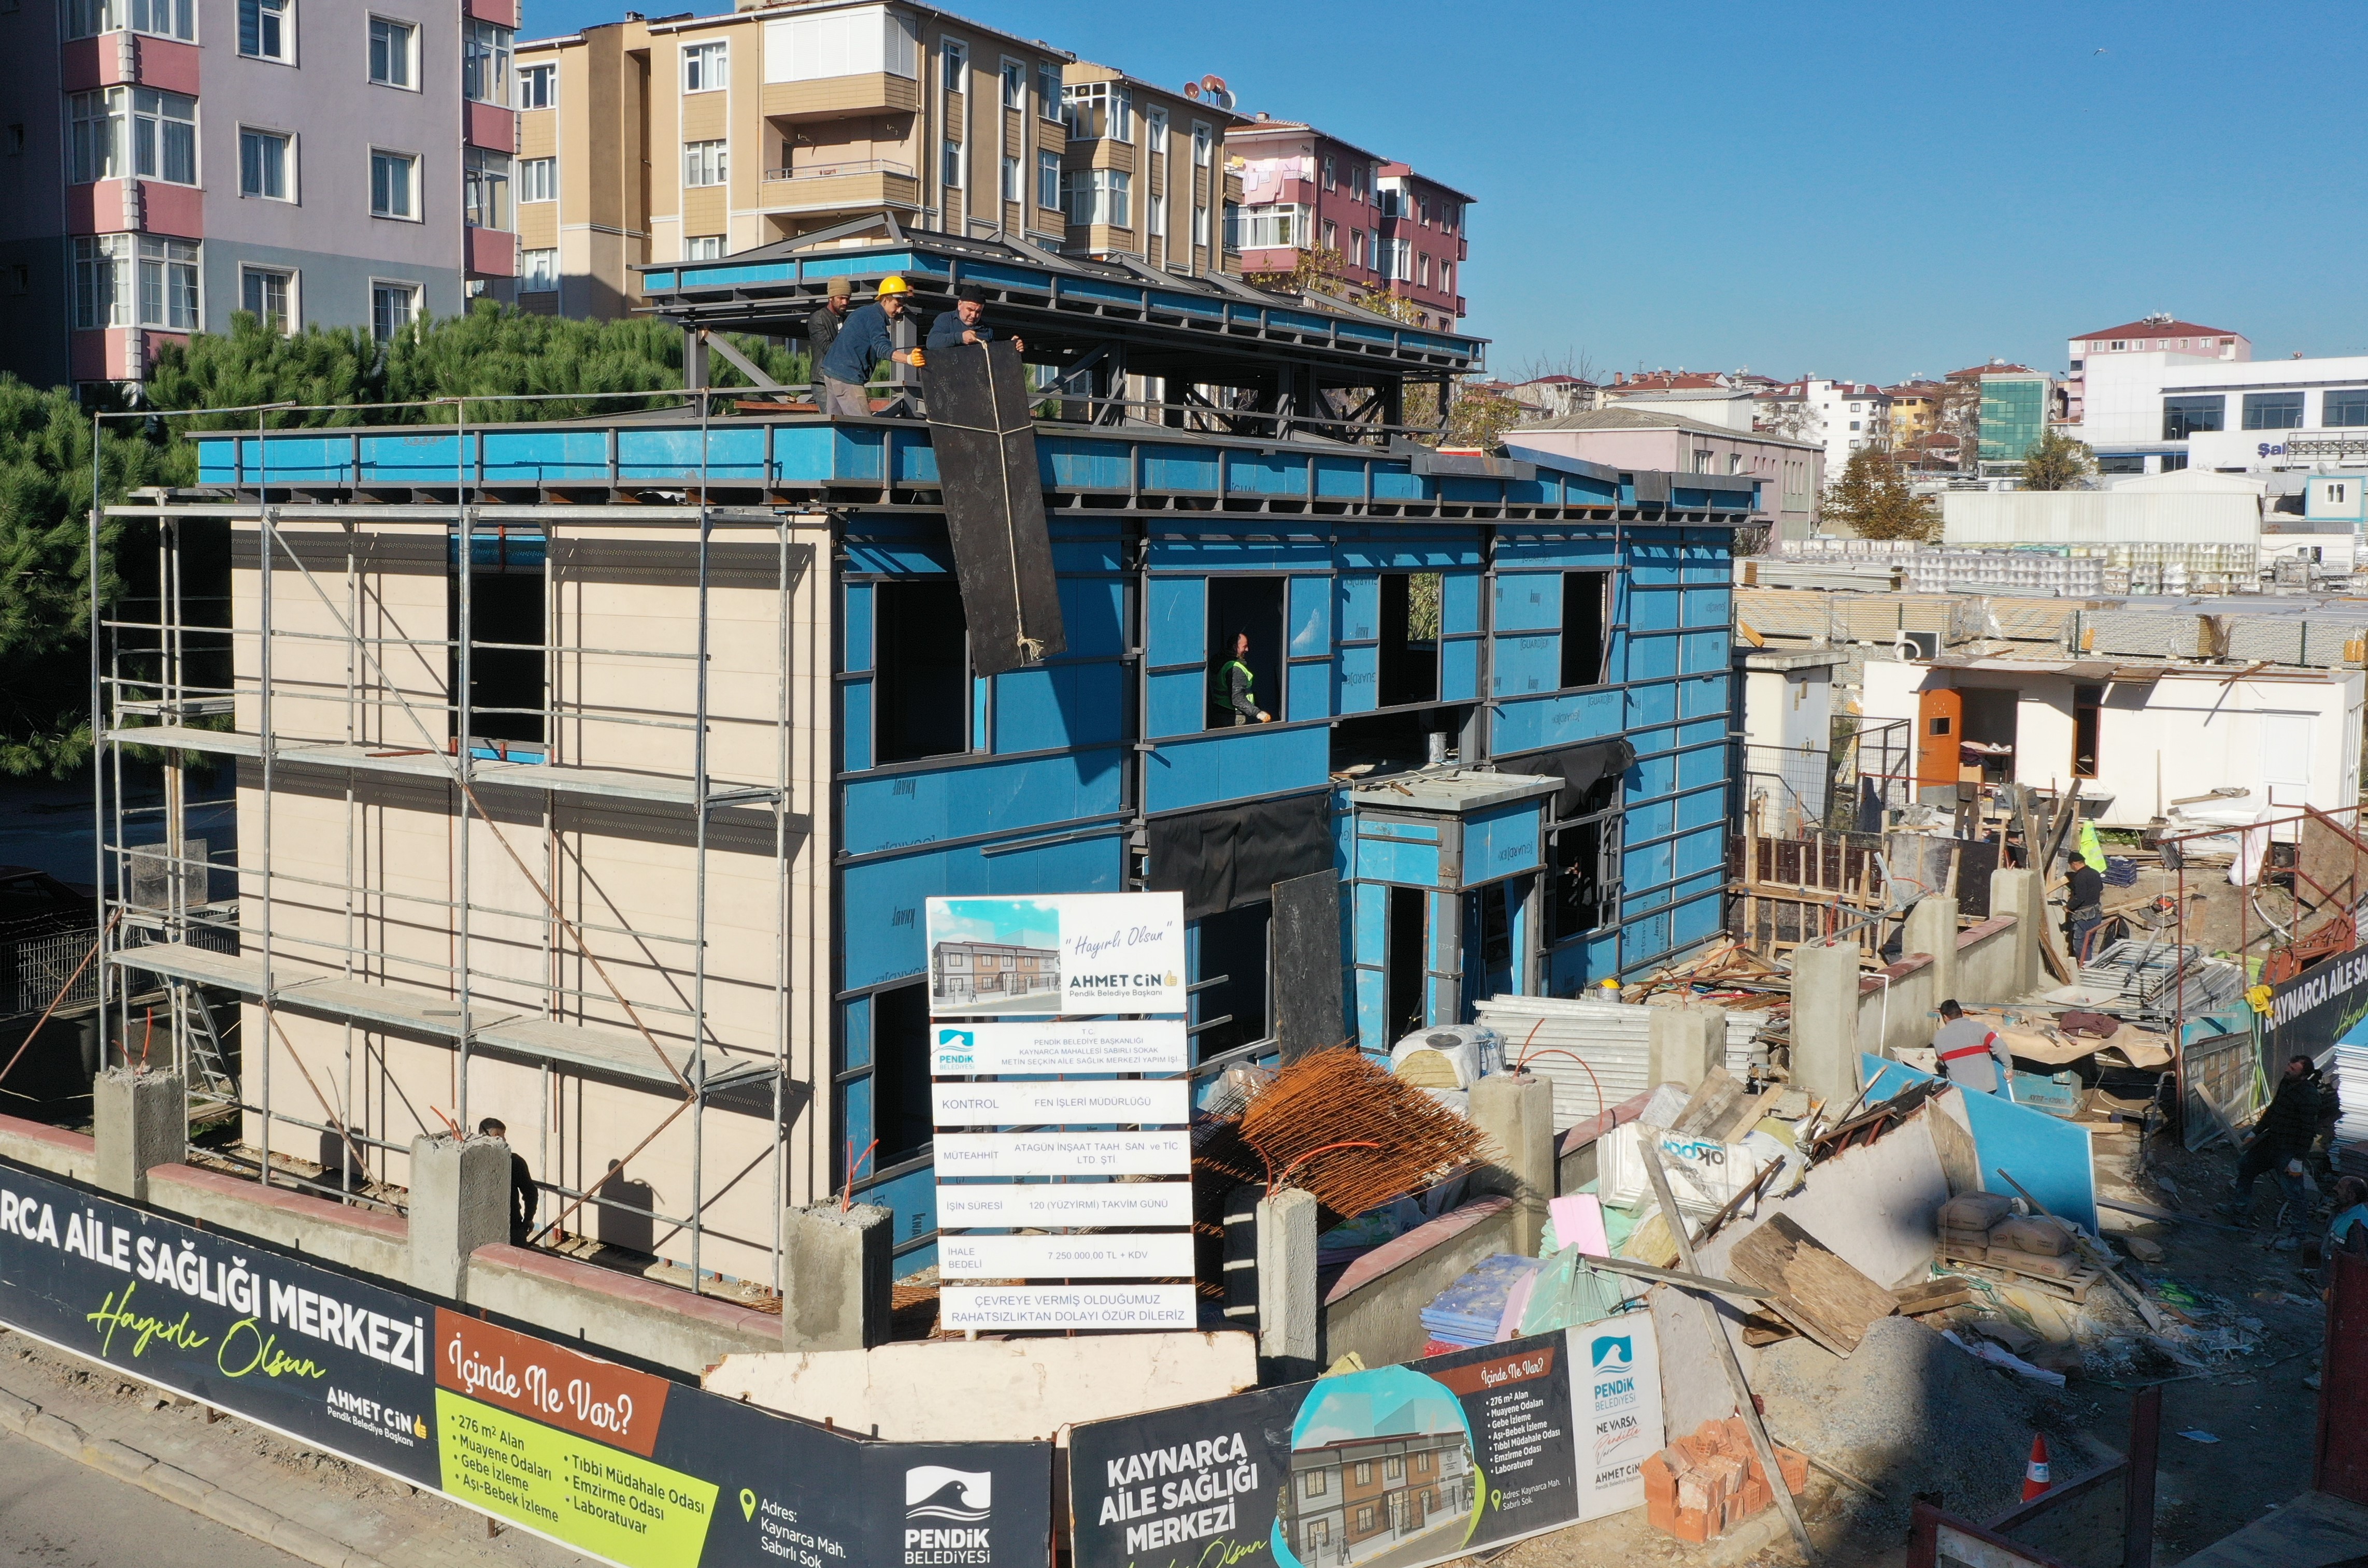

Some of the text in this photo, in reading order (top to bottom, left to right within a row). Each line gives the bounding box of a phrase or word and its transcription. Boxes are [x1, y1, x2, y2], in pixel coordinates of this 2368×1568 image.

[1069, 974, 1129, 988] AHMET
[2329, 960, 2352, 999] AİLE
[2353, 954, 2368, 985] SA
[1069, 988, 1162, 998] Pendik Belediye Başkanı
[1061, 1046, 1102, 1055] MAHALLESİ
[1100, 1037, 1144, 1046] BAŞKANLIĞI
[1002, 1057, 1026, 1066] METİN
[1028, 1057, 1057, 1066] SEÇKİN
[1077, 1056, 1104, 1064] SAĞLIK
[1106, 1055, 1141, 1063] MERKEZİ
[942, 1099, 1000, 1109] KONTROL
[1034, 1096, 1151, 1107] FEN İŞLERİ MÜDÜRLÜĞÜ
[944, 1150, 999, 1160] MÜTEAHHİT
[1015, 1141, 1054, 1152] ATAGÜN
[1057, 1141, 1092, 1153] İNŞAAT
[1093, 1142, 1122, 1150] TAAH.
[1125, 1142, 1147, 1150] SAN.
[947, 1200, 1003, 1211] İŞİN SÜRESİ
[1029, 1199, 1168, 1211] 120 (YÜZYİRMİ) TAKVİM GÜNÜ
[948, 1247, 975, 1256] İHALE
[1048, 1251, 1104, 1260] 7.250.000,00
[948, 1259, 982, 1269] BEDELİ
[0, 1188, 424, 1376] RCA AİLE SAĞLIĞI MERKEZİ
[975, 1293, 1161, 1308] ÇEVREYE VERMİŞ OLDUĞUMUZ
[952, 1308, 1185, 1321] RAHATSIZLIKTAN DOLAYI ÖZÜR DİLERİZ
[217, 1317, 325, 1378] Olsun
[1481, 1357, 1544, 1388] İçinde Ne Var?
[449, 1332, 632, 1436] İçinde Ne Var?
[326, 1386, 381, 1420] AHMET
[1490, 1397, 1502, 1407] 276
[1514, 1390, 1529, 1401] Alan
[1491, 1399, 1544, 1419] Muayene Odaları
[327, 1406, 413, 1446] Pendik Belediye Başkanı
[1492, 1412, 1531, 1429] Gebe İzleme
[1493, 1419, 1547, 1442] Aşı-Bebek İzleme
[1596, 1415, 1637, 1435] NE VARSA
[459, 1415, 478, 1434] 276
[500, 1430, 524, 1451] Alan
[1511, 1432, 1542, 1449] Müdahale
[1543, 1428, 1561, 1442] Odası
[460, 1434, 552, 1481] Muayene Odaları
[1107, 1432, 1248, 1488] KAYNARCA
[1494, 1444, 1542, 1463] Emzirme Odası
[461, 1456, 529, 1492] Gebe İzleme
[1495, 1457, 1534, 1474] Laboratuvar
[1595, 1466, 1624, 1485] AHMET
[572, 1454, 705, 1515] Tıbbi Müdahale Odası
[1099, 1460, 1258, 1527] AİLE SAĞLIĞI
[1503, 1478, 1561, 1500] Adres: Kaynarca Mah.
[463, 1473, 559, 1523] Aşı-Bebek İzleme
[573, 1475, 664, 1521] Emzirme Odası
[1503, 1497, 1534, 1511] Sabırlı Sok.
[574, 1496, 647, 1535] Laboratuvar
[761, 1498, 797, 1523] Adres:
[1126, 1497, 1236, 1556] MERKEZİ
[761, 1518, 846, 1559] Kaynarca Mah.
[761, 1536, 796, 1562] Sabırlı
